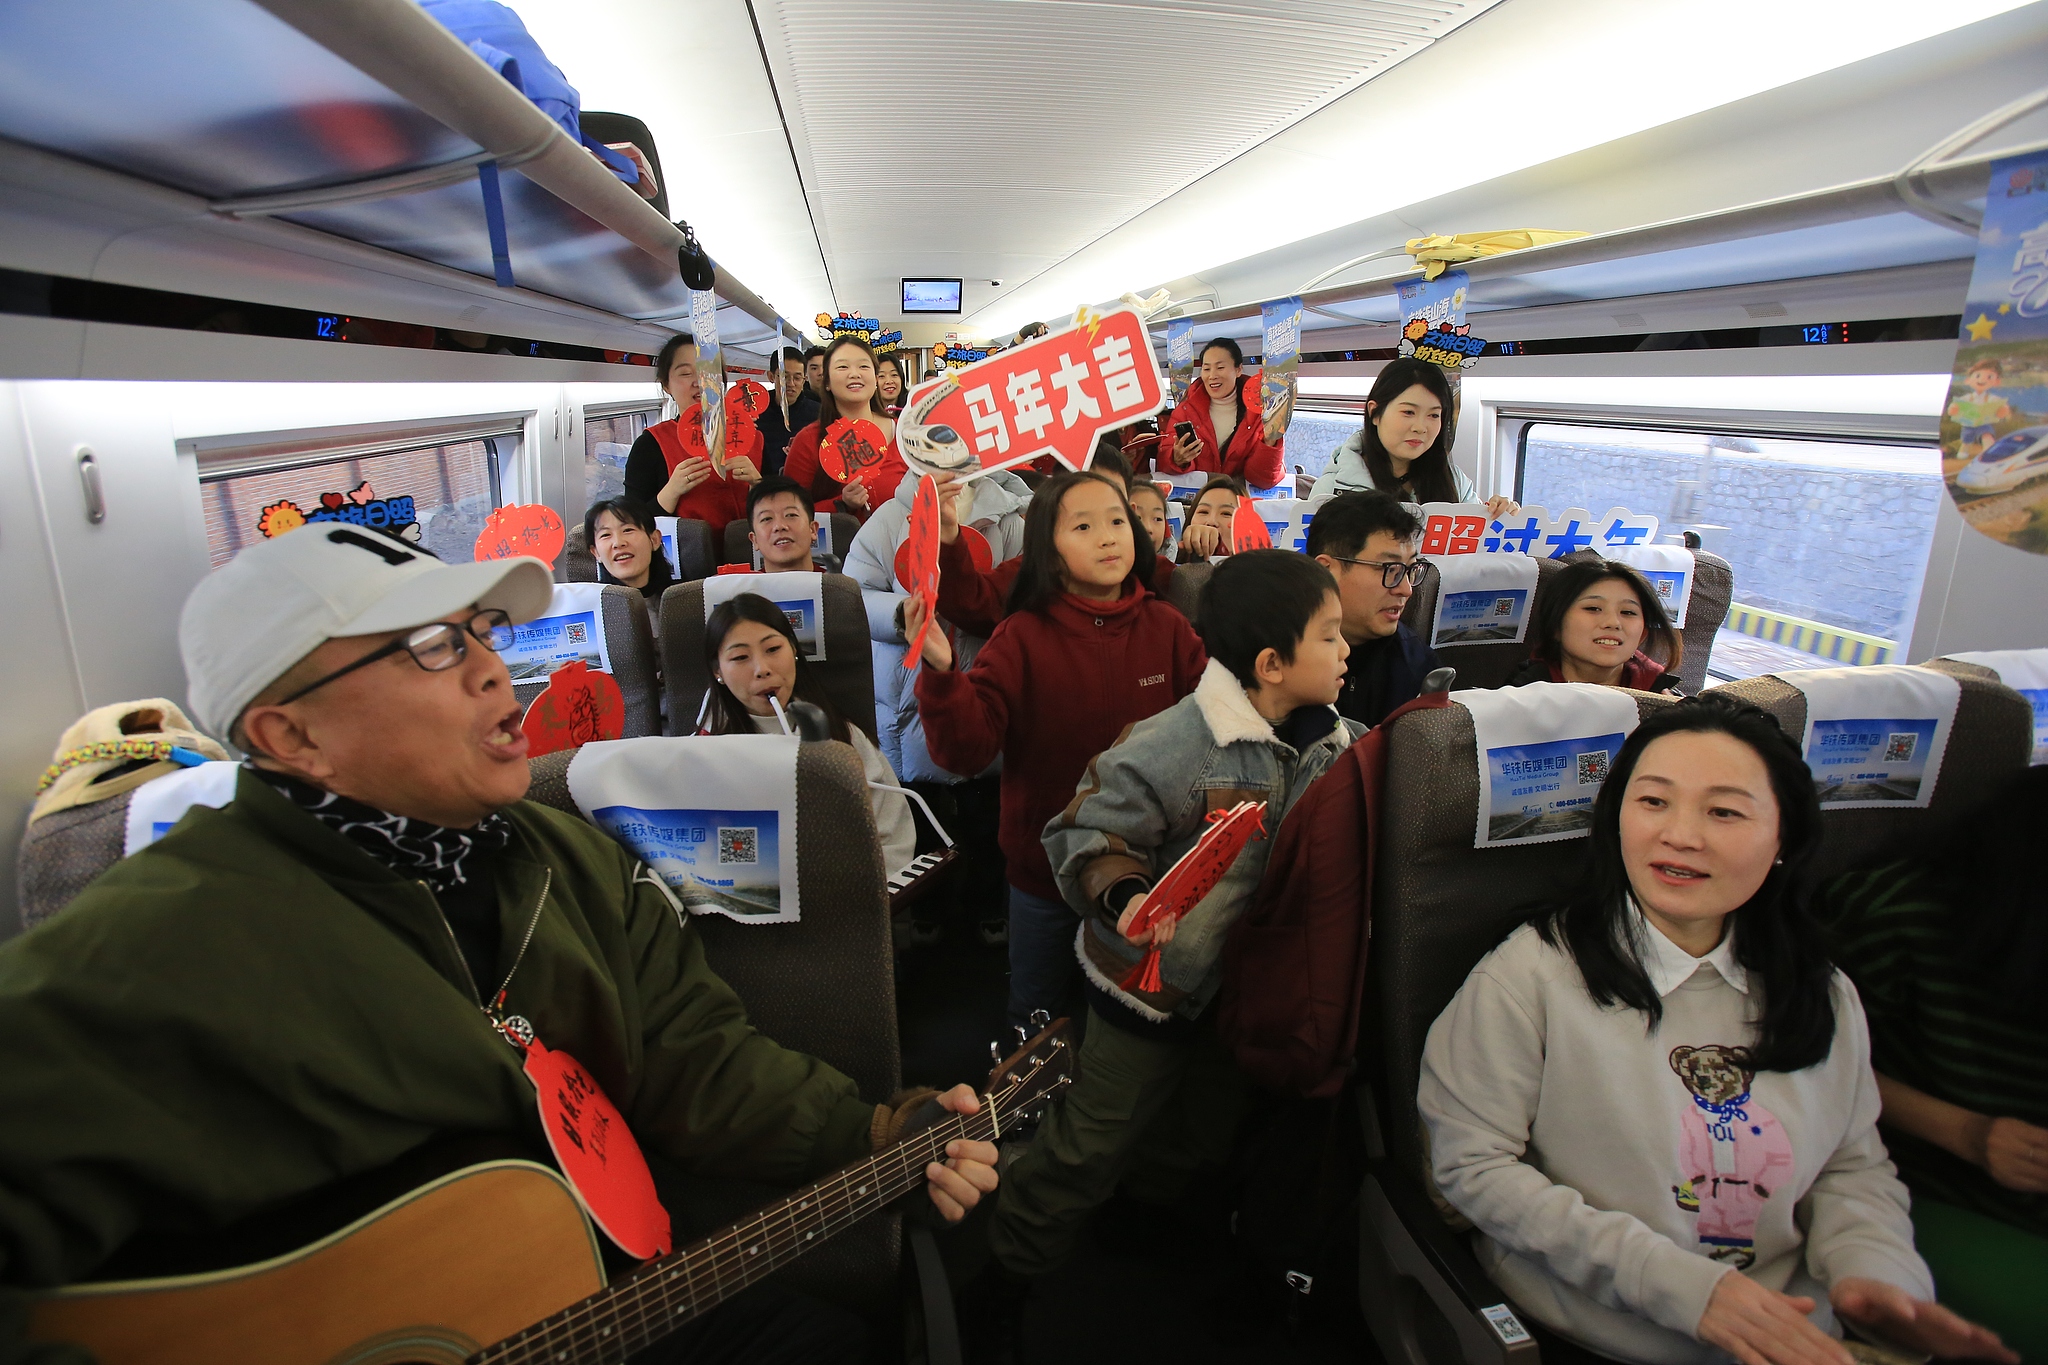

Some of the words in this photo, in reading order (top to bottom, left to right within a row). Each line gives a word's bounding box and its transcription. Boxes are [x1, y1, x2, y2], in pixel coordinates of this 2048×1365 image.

[317, 317, 331, 337] 12
[833, 317, 879, 331] 文旅日照
[1423, 330, 1486, 356] 文旅日照
[1803, 327, 1820, 342] 12
[963, 335, 1145, 454] 马年大吉
[1820, 733, 1880, 746] 华铁传媒集团
[1501, 755, 1568, 776] 华铁传媒集团
[1542, 771, 1560, 779] Group
[1534, 782, 1561, 793] 文明出行
[616, 823, 706, 843] 华铁传媒集团
